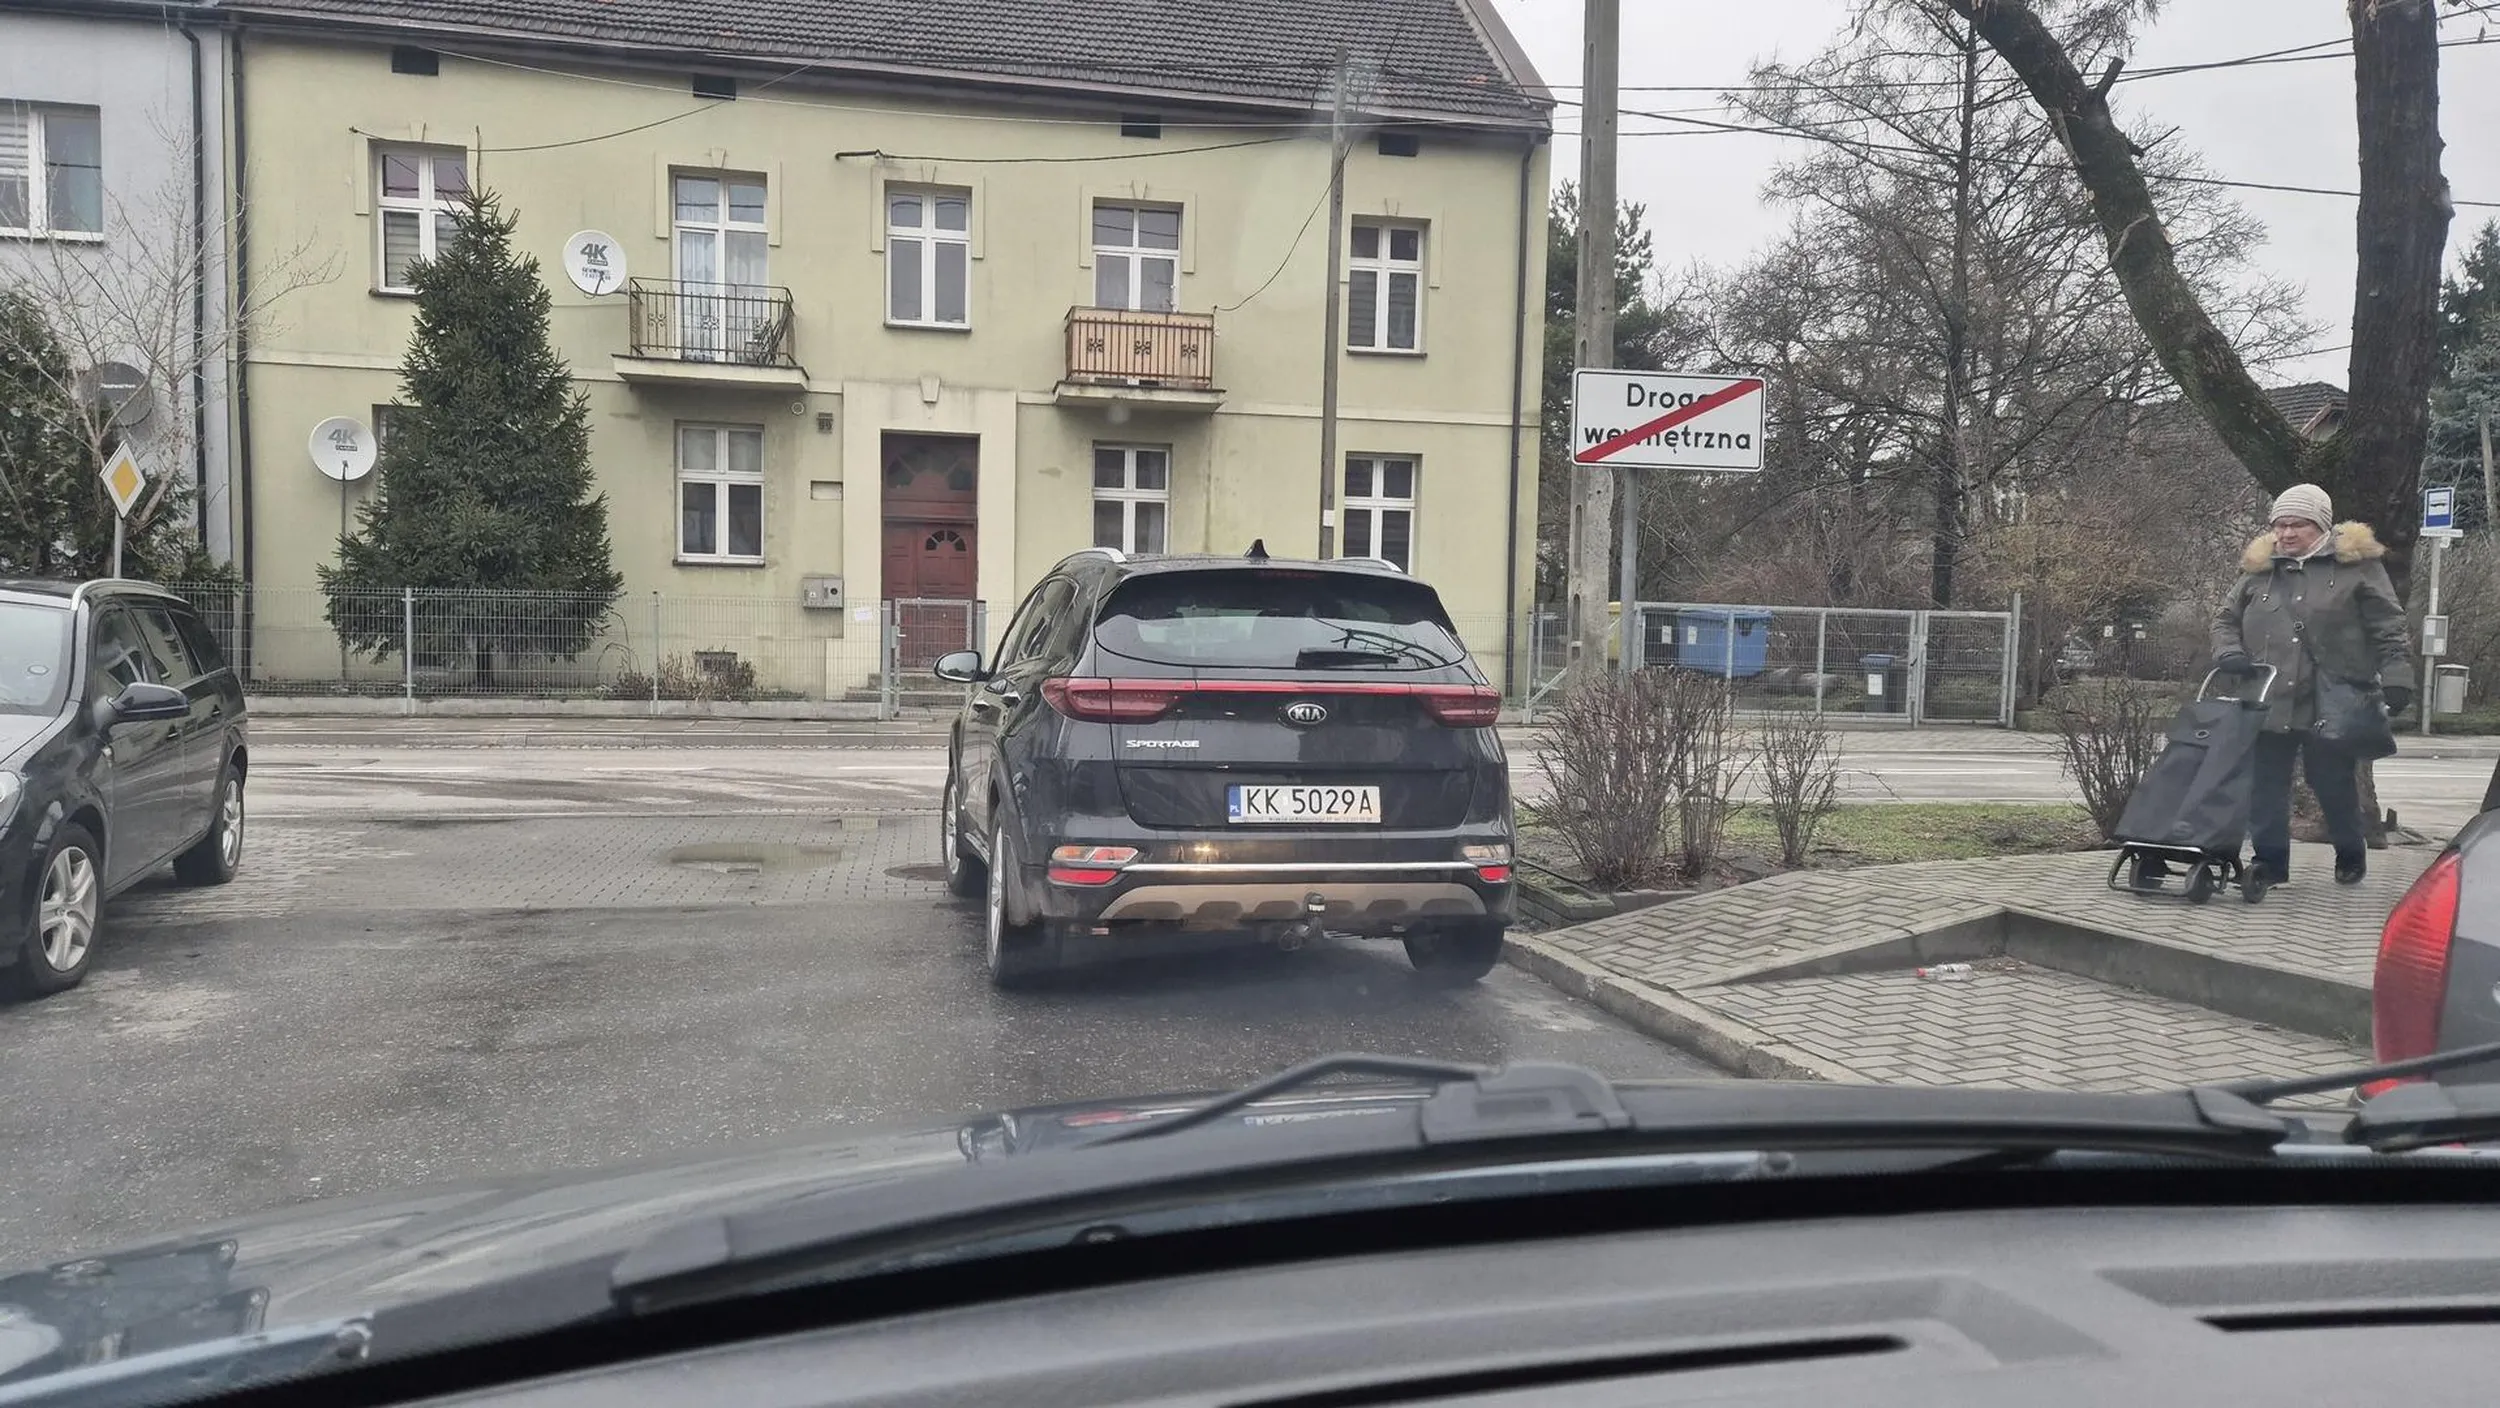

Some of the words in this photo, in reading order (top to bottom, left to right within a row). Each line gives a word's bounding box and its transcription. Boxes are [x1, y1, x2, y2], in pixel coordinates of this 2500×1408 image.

[580, 243, 608, 260] 4K
[1627, 383, 1714, 408] Drog
[327, 428, 357, 445] 4K
[1584, 424, 1751, 454] wenętrzna
[1294, 706, 1322, 719] KIA
[1126, 739, 1200, 749] SPORTAGE
[1230, 805, 1240, 813] PL
[1247, 788, 1279, 814] KK
[1292, 788, 1373, 814] 5029A
